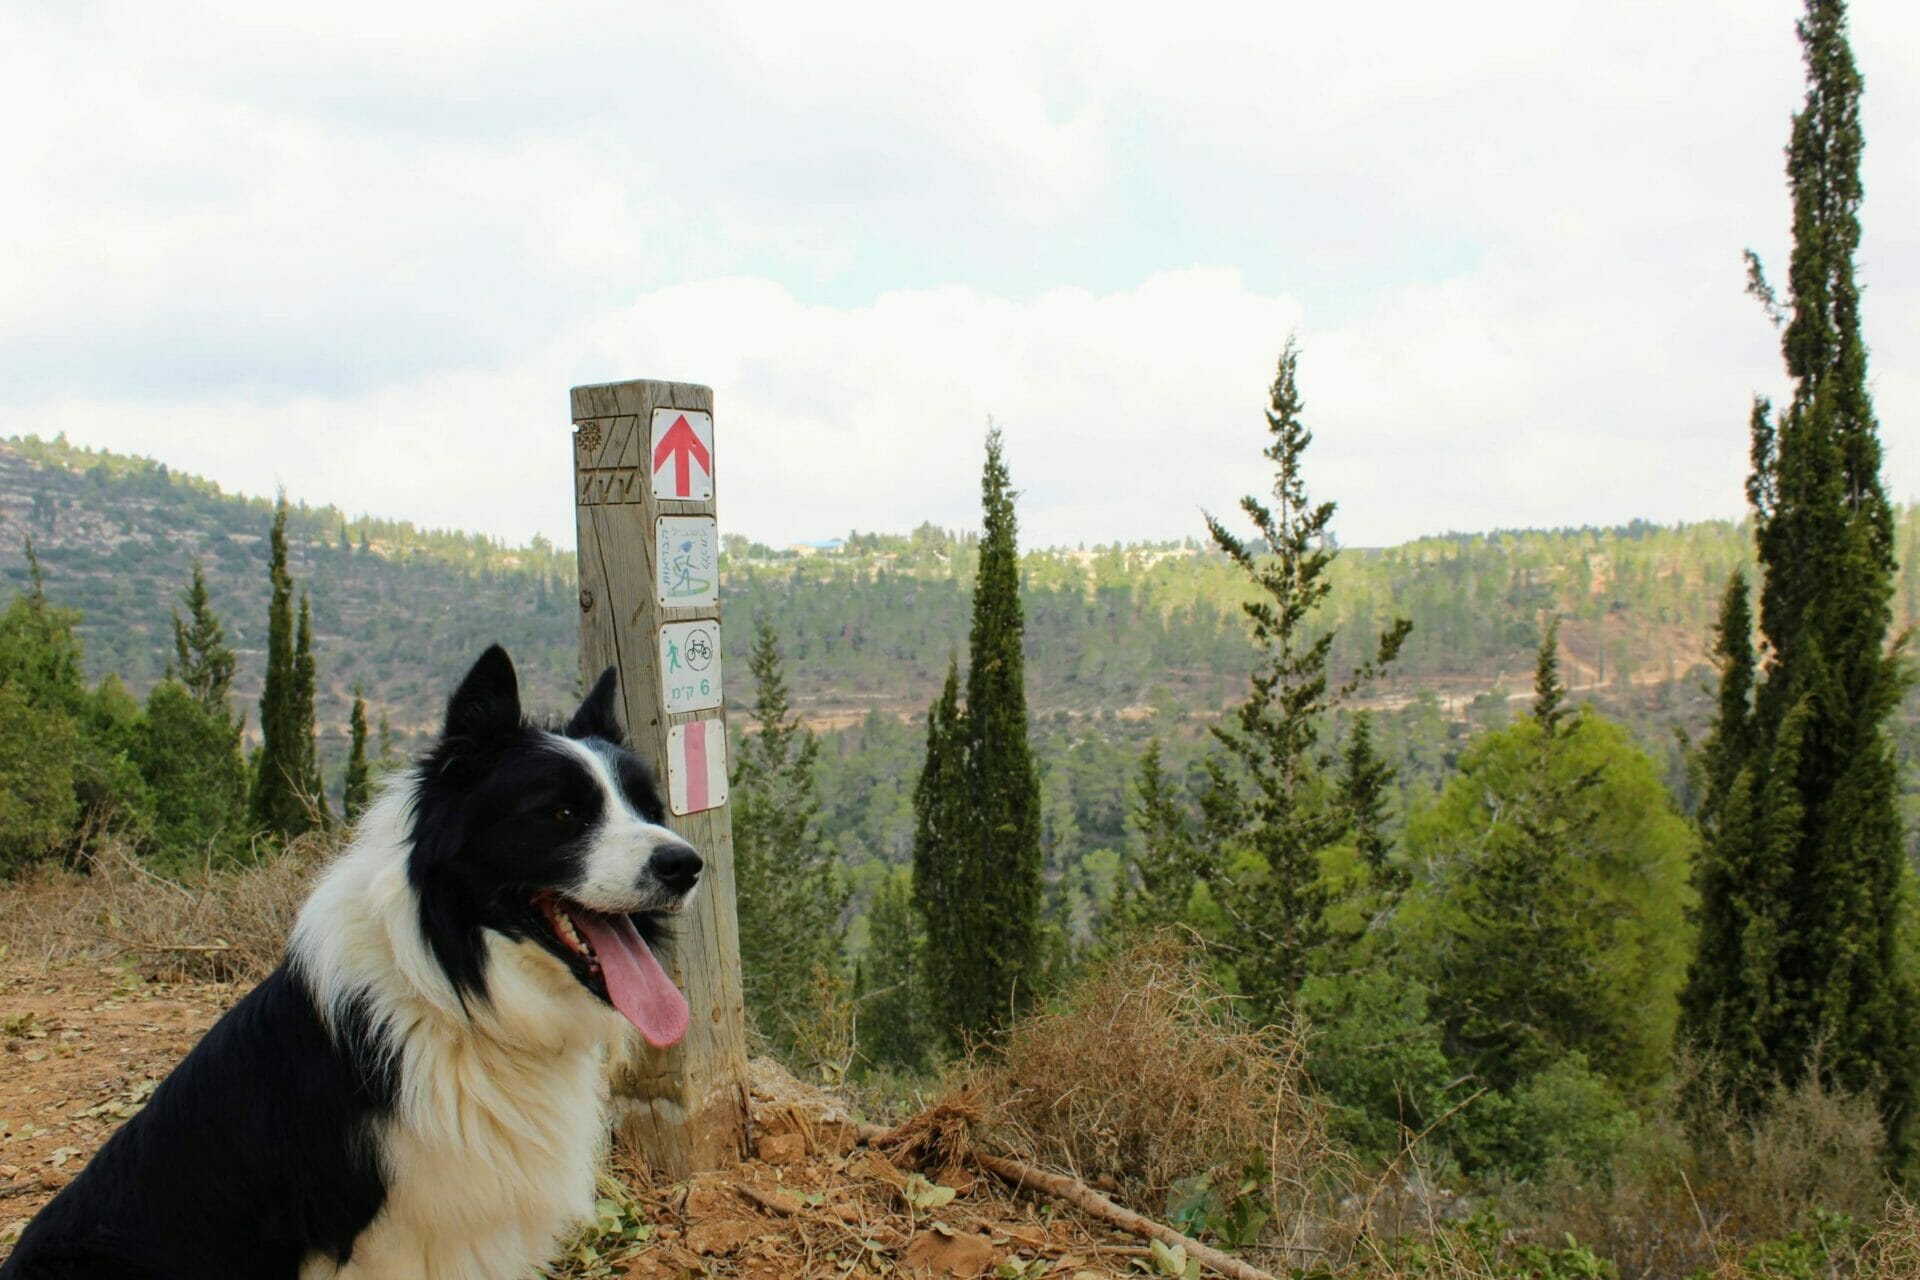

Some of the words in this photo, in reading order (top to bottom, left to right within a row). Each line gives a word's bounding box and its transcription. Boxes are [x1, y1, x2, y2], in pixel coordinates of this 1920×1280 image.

[672, 526, 707, 537] בשביל
[662, 529, 670, 586] הבריאות
[700, 678, 710, 696] 6
